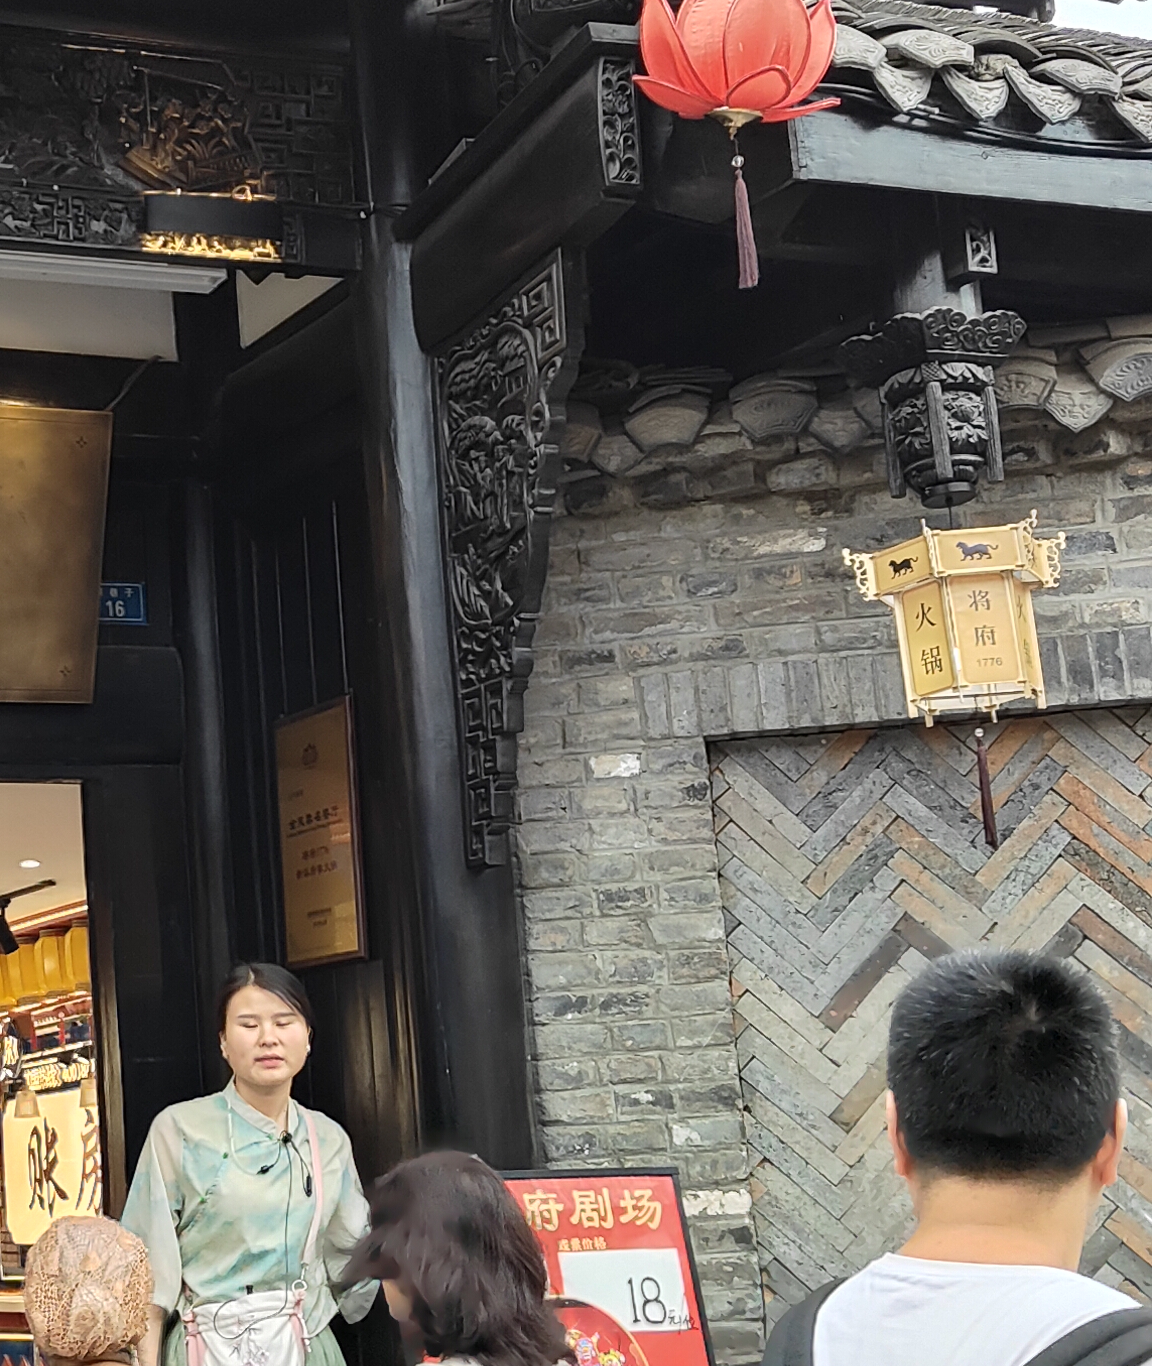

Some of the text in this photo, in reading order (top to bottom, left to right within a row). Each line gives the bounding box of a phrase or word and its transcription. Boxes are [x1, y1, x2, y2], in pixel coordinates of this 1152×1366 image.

[105, 600, 125, 617] 16
[967, 589, 997, 648] 将府
[914, 602, 944, 676] 火锅
[976, 657, 1003, 668] 1776
[523, 1187, 662, 1232] 府剧场
